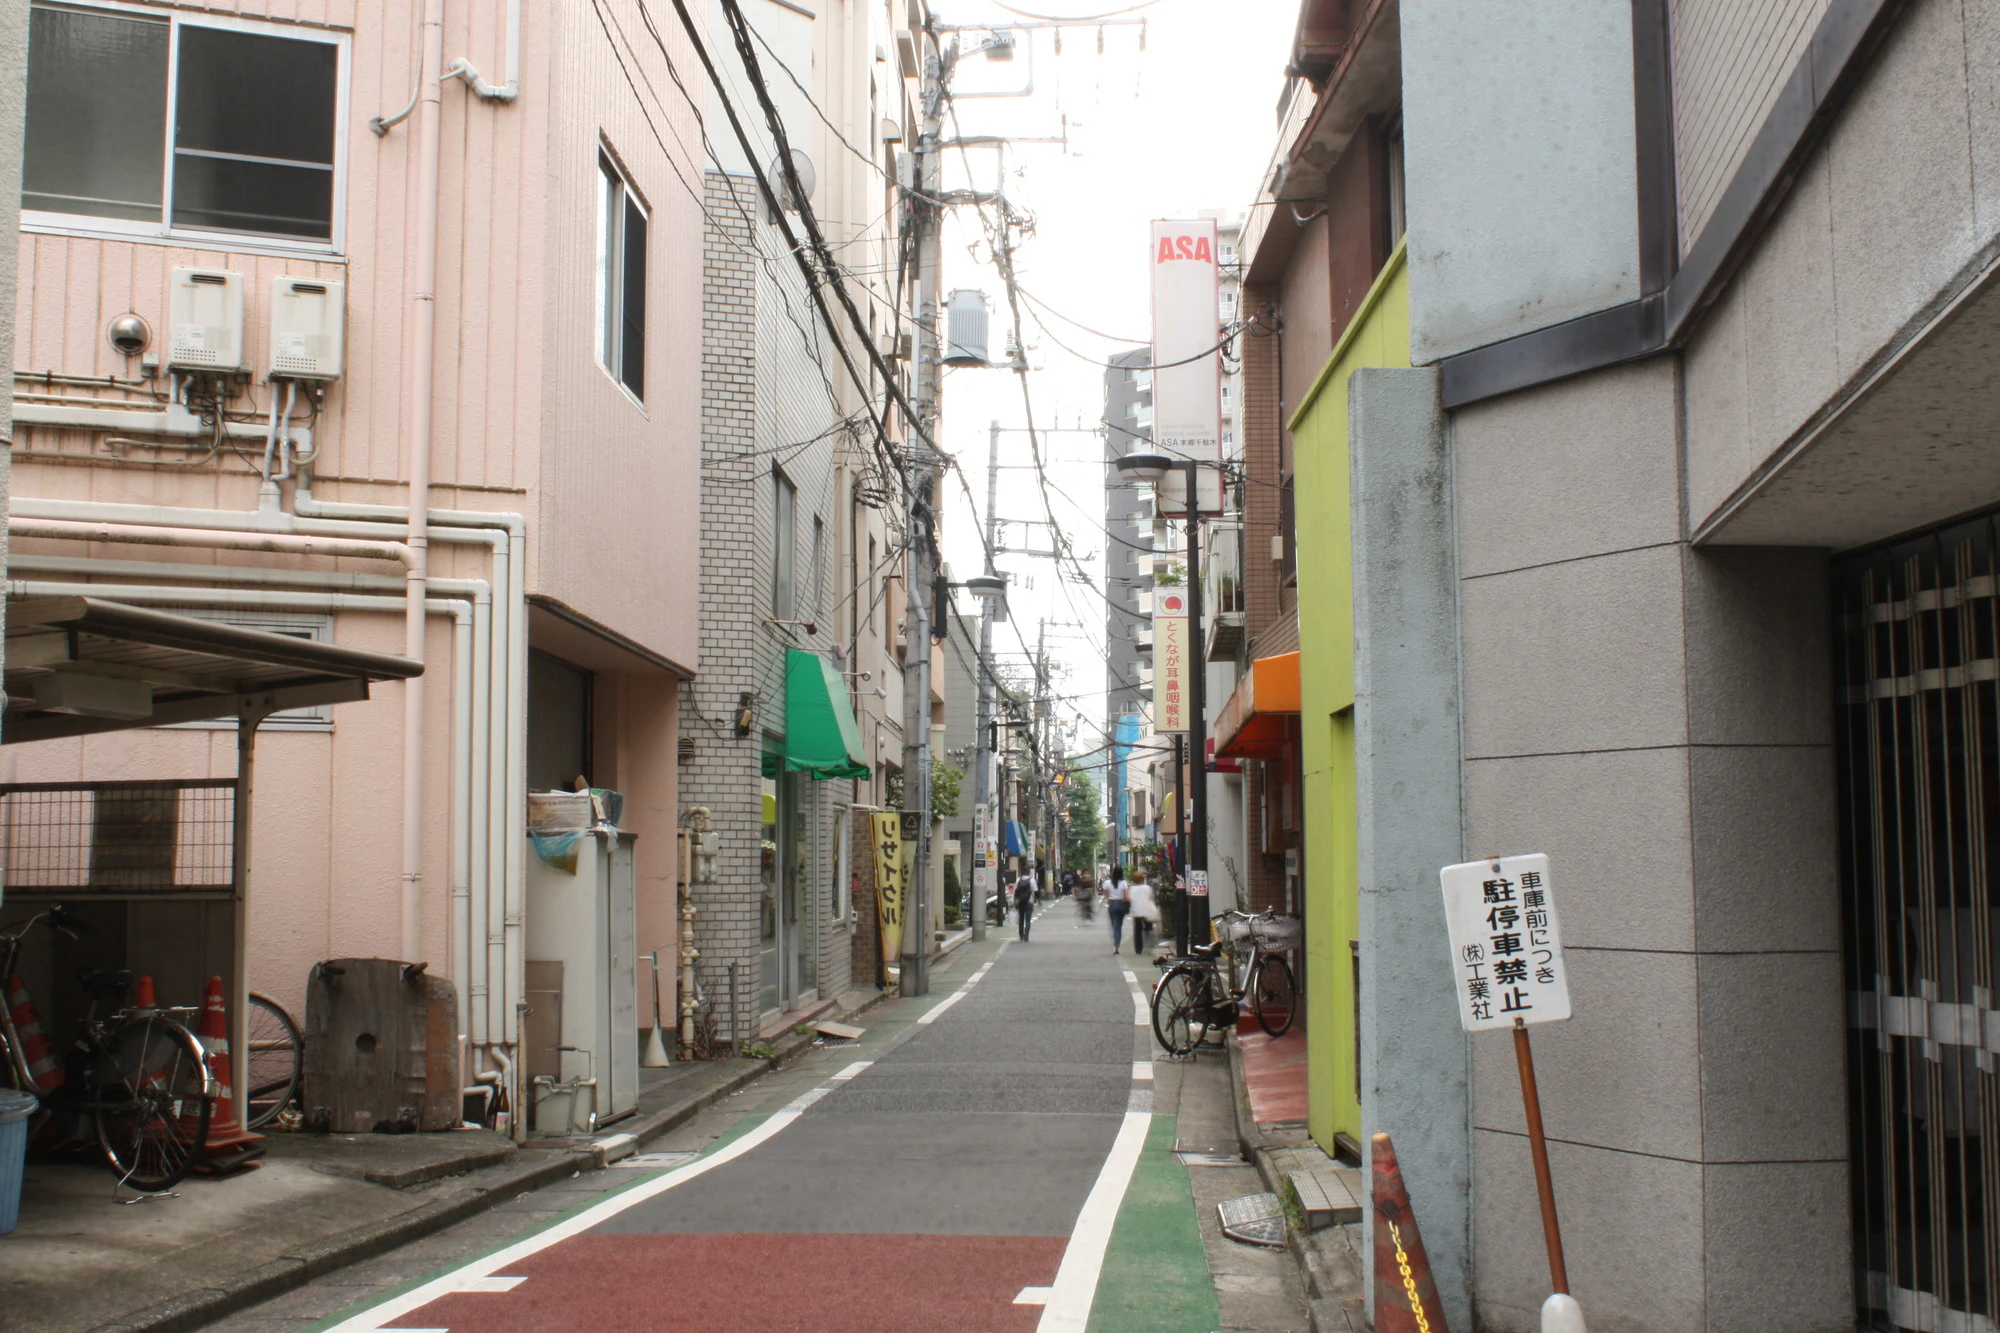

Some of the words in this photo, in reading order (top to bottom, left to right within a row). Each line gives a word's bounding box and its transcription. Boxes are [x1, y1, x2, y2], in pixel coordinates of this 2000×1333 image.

[1157, 236, 1212, 264] ASA
[1161, 438, 1178, 447] ASA
[1166, 621, 1180, 728] とくなが耳鼻咽喉科
[1483, 878, 1532, 1013] 駐停車禁止
[1520, 871, 1555, 984] 車庫前につき
